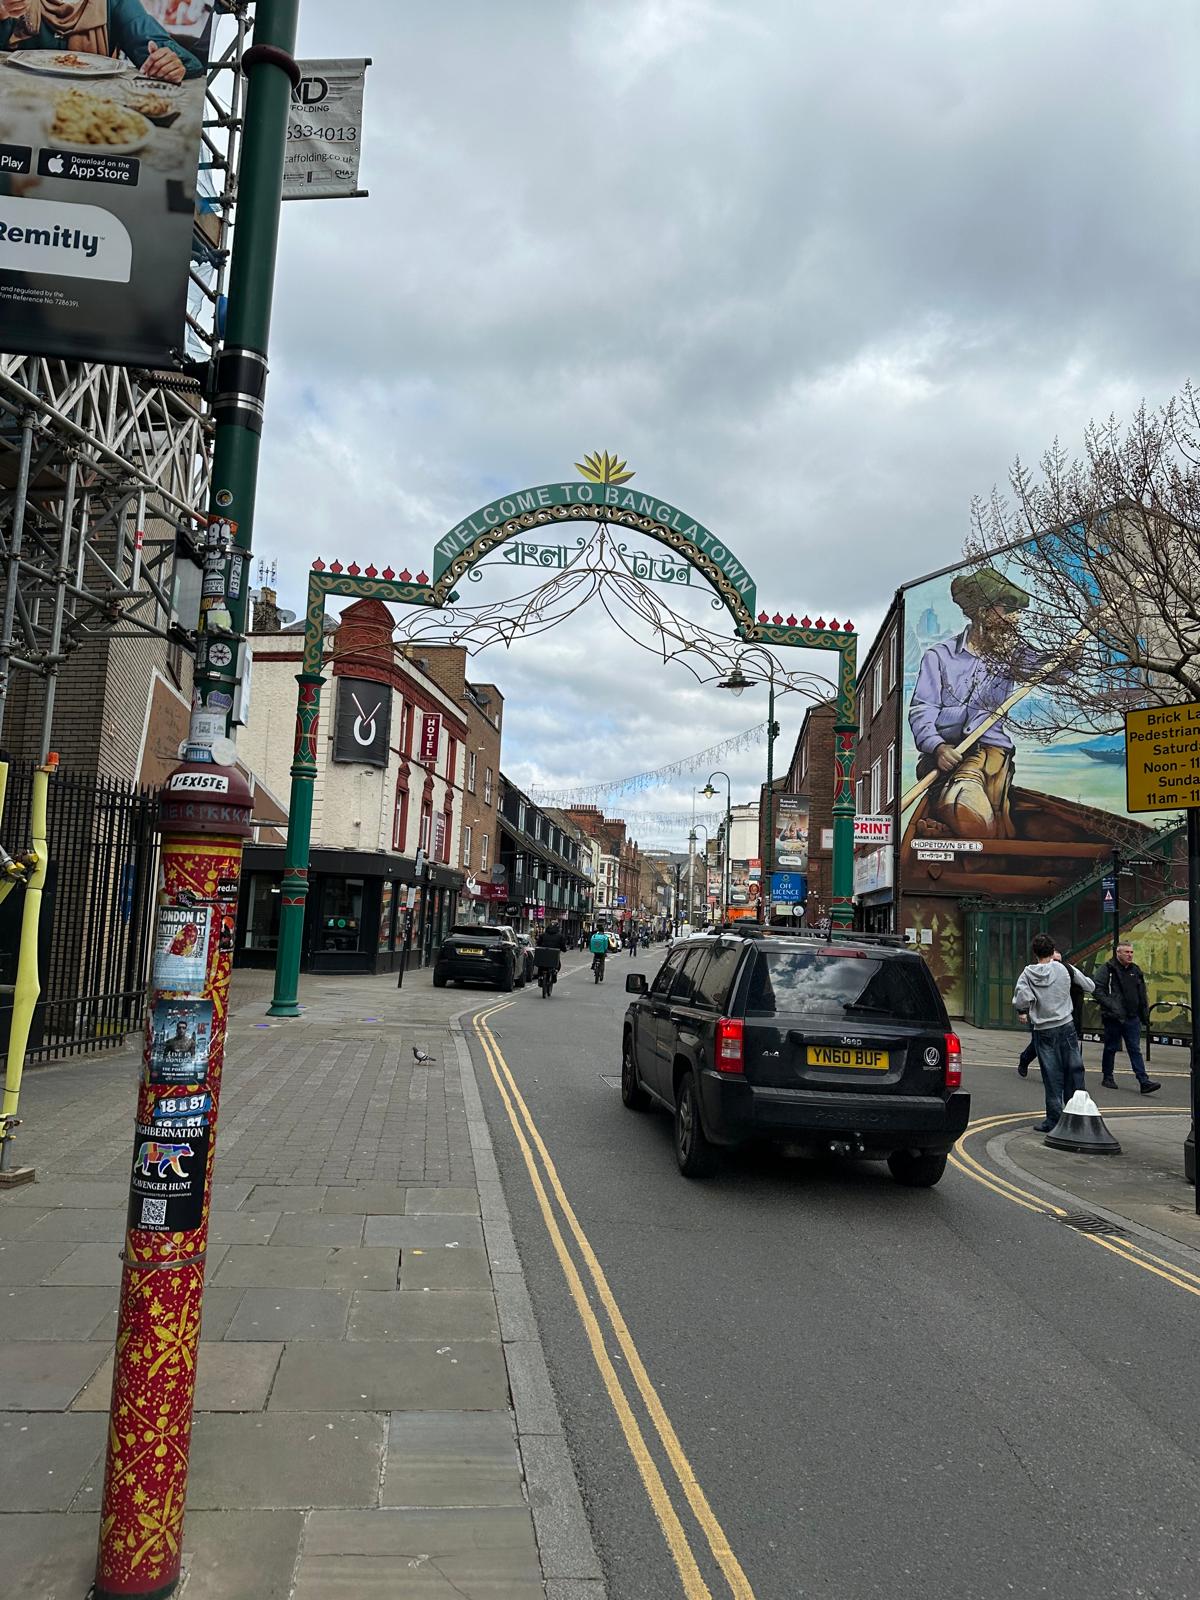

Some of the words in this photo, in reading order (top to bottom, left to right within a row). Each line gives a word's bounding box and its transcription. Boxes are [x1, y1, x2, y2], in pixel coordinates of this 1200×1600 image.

[290, 104, 330, 113] FOLDING
[1, 155, 24, 171] Play
[71, 156, 106, 167] Download
[107, 159, 116, 167] on
[118, 161, 130, 169] the
[69, 164, 96, 179] App
[97, 166, 130, 181] Store
[12, 294, 43, 304] Reference
[14, 287, 44, 297] regulated
[437, 486, 553, 560] WELCOME
[560, 484, 593, 503] TO
[604, 485, 753, 595] BANGLATOWN
[502, 541, 567, 569] বাংলা
[633, 551, 692, 585] টাউন
[1147, 711, 1181, 726] Brick
[426, 718, 436, 756] HOTEL
[1129, 726, 1200, 743] Pedestrian
[1153, 740, 1200, 756] Saturd
[1143, 762, 1178, 774] Noon
[172, 775, 226, 790] J'EXISTE.
[854, 823, 891, 835] PRINT
[914, 841, 955, 849] HOPETOWN
[772, 888, 800, 896] LICENCE
[779, 882, 793, 890] OFF
[159, 910, 194, 924] LONDON
[195, 911, 206, 923] IS
[840, 1036, 862, 1046] Jeep
[814, 1048, 850, 1064] YN60
[855, 1049, 883, 1066] BUF
[160, 1099, 177, 1113] 18
[189, 1094, 206, 1110] 87
[168, 1181, 192, 1191] HUNT
